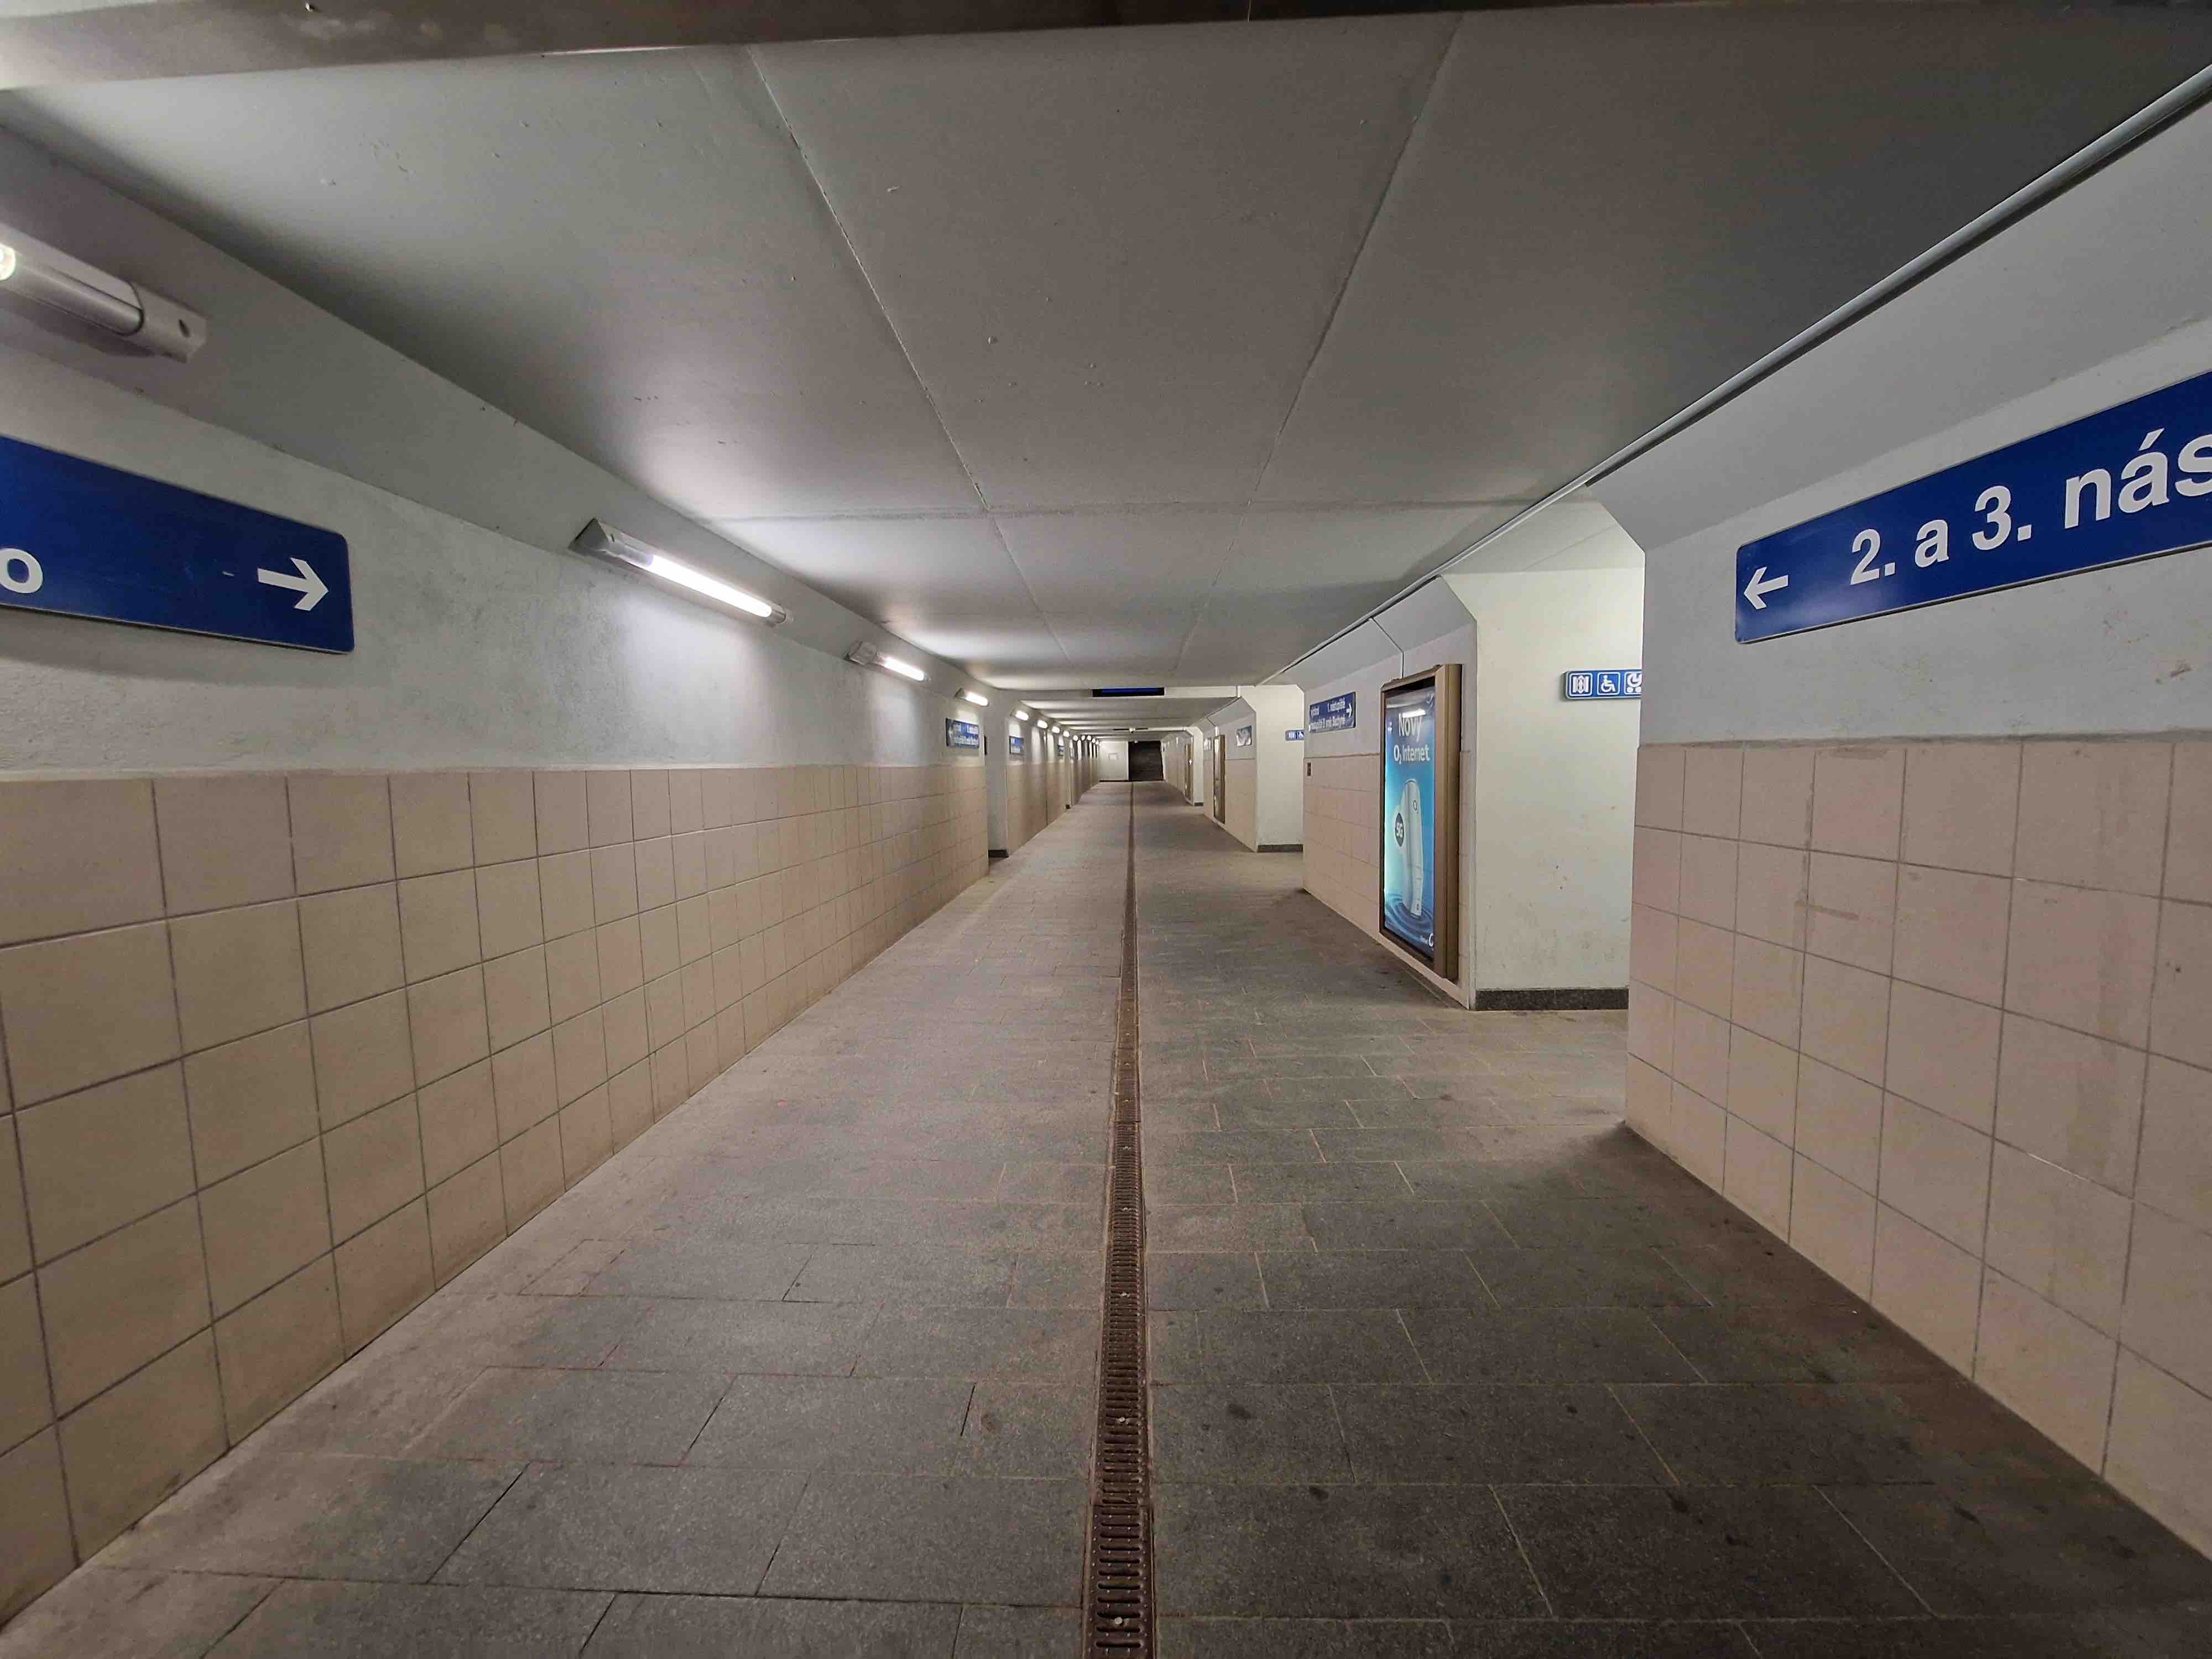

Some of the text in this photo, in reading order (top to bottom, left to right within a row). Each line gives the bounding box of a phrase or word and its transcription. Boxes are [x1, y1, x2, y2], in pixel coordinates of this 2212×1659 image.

[1850, 528, 1896, 585] 2.
[1914, 519, 1949, 568] a
[1972, 485, 2032, 551] 3.
